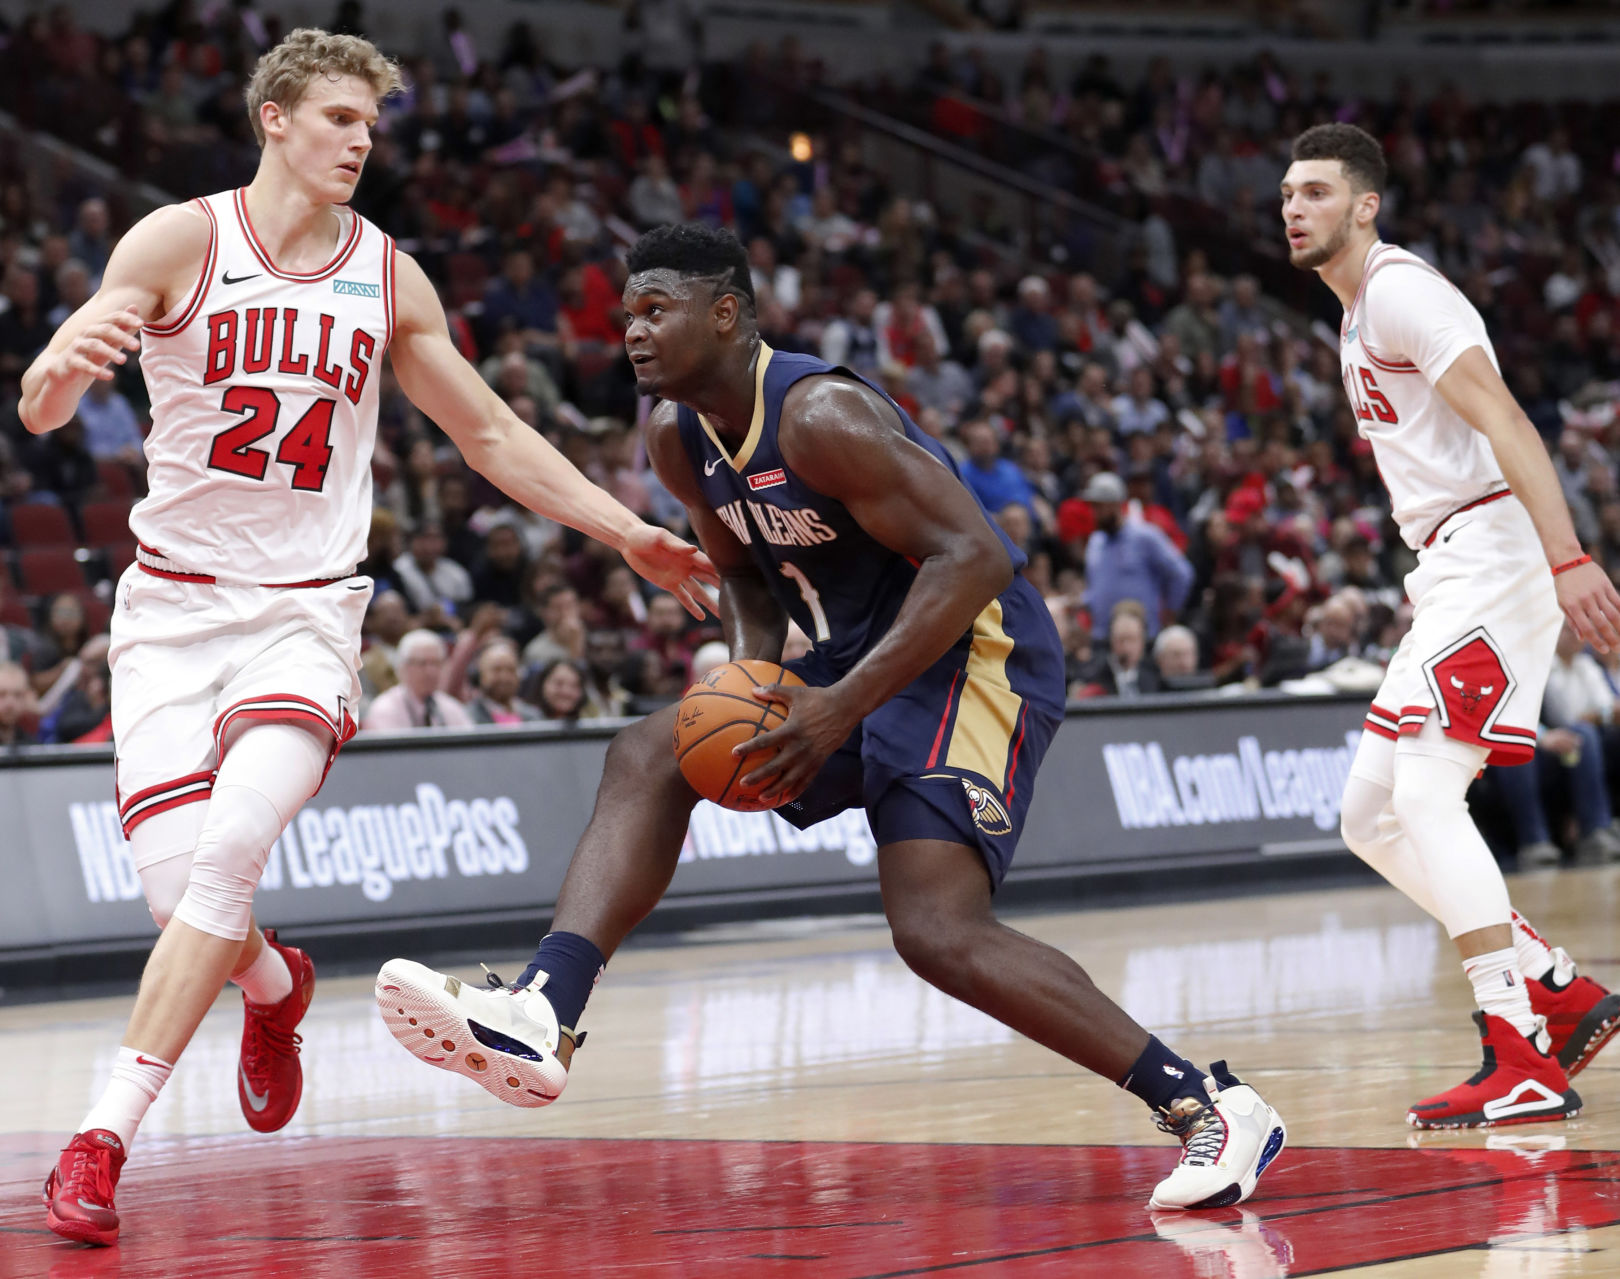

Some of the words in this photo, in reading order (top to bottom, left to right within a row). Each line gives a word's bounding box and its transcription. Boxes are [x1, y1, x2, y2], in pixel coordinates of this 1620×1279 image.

[334, 280, 380, 298] ZENNI
[203, 307, 376, 406] BULLS
[207, 385, 338, 493] 24
[779, 561, 831, 642] 1
[1102, 730, 1363, 831] NBA.com/League
